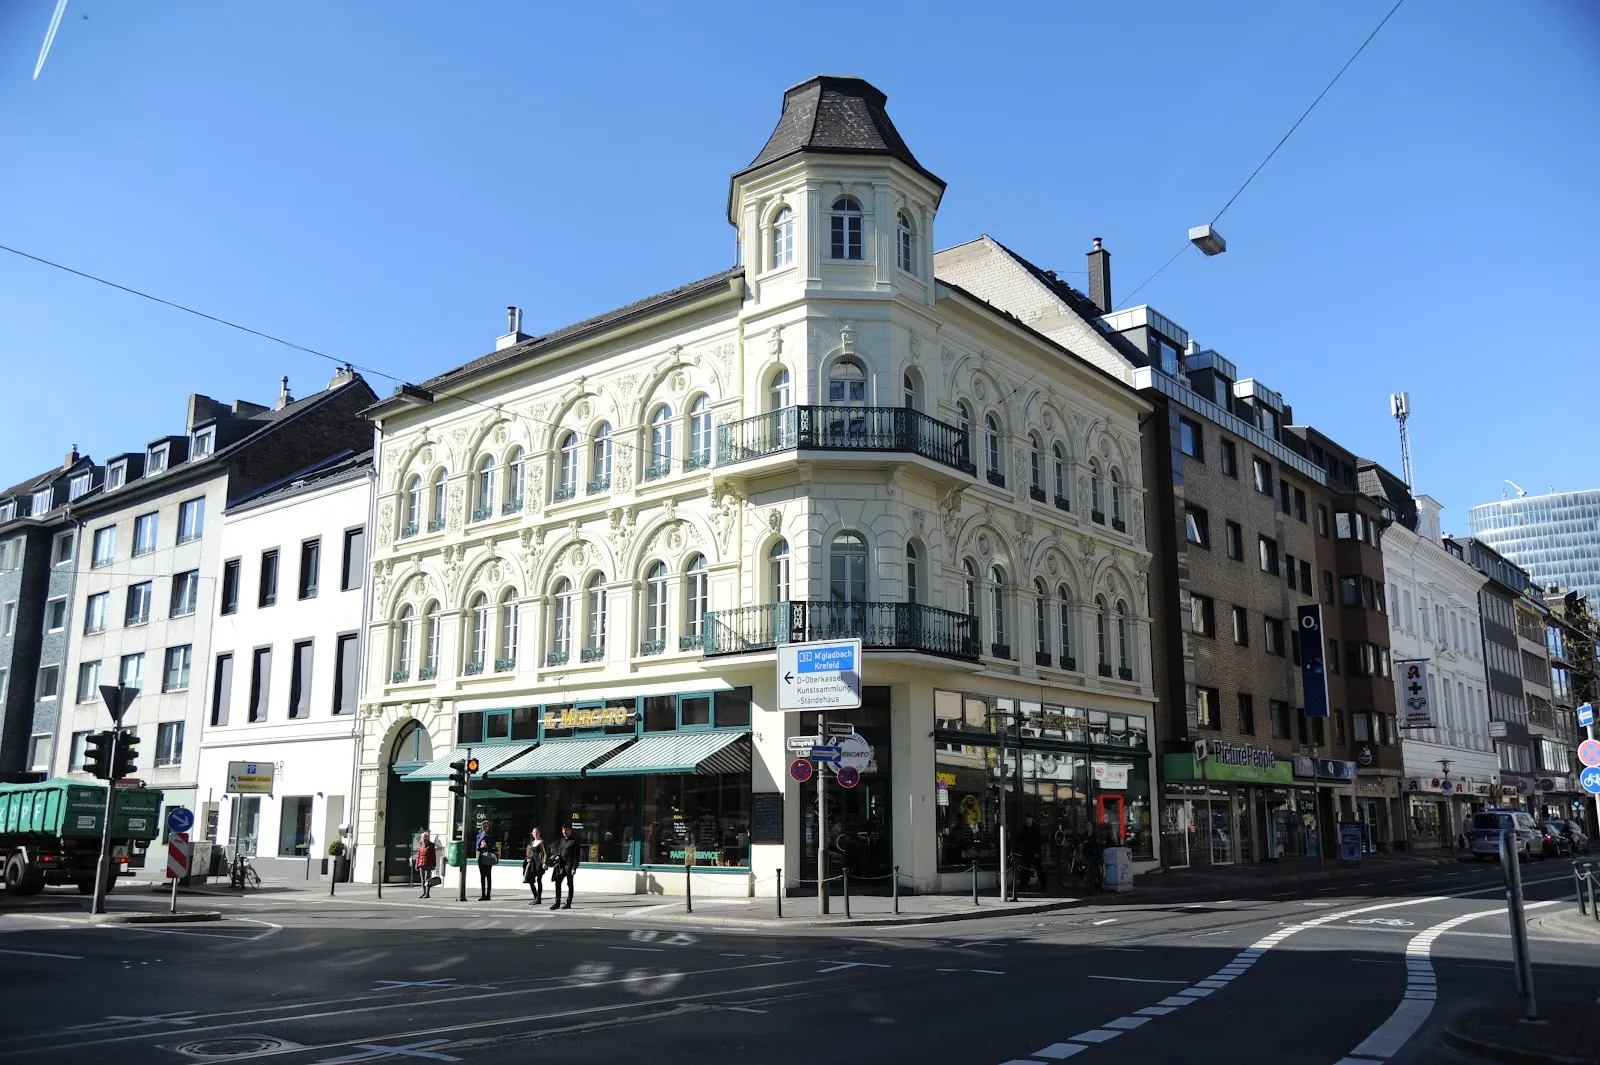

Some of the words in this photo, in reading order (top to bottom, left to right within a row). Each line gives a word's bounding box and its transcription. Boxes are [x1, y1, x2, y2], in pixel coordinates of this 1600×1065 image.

[815, 661, 840, 670] Krefeld
[797, 675, 843, 684] D-Oberkassel
[797, 685, 852, 694] Kunstsammlung
[560, 706, 627, 728] MERCATO
[1213, 740, 1276, 773] PicturePeople
